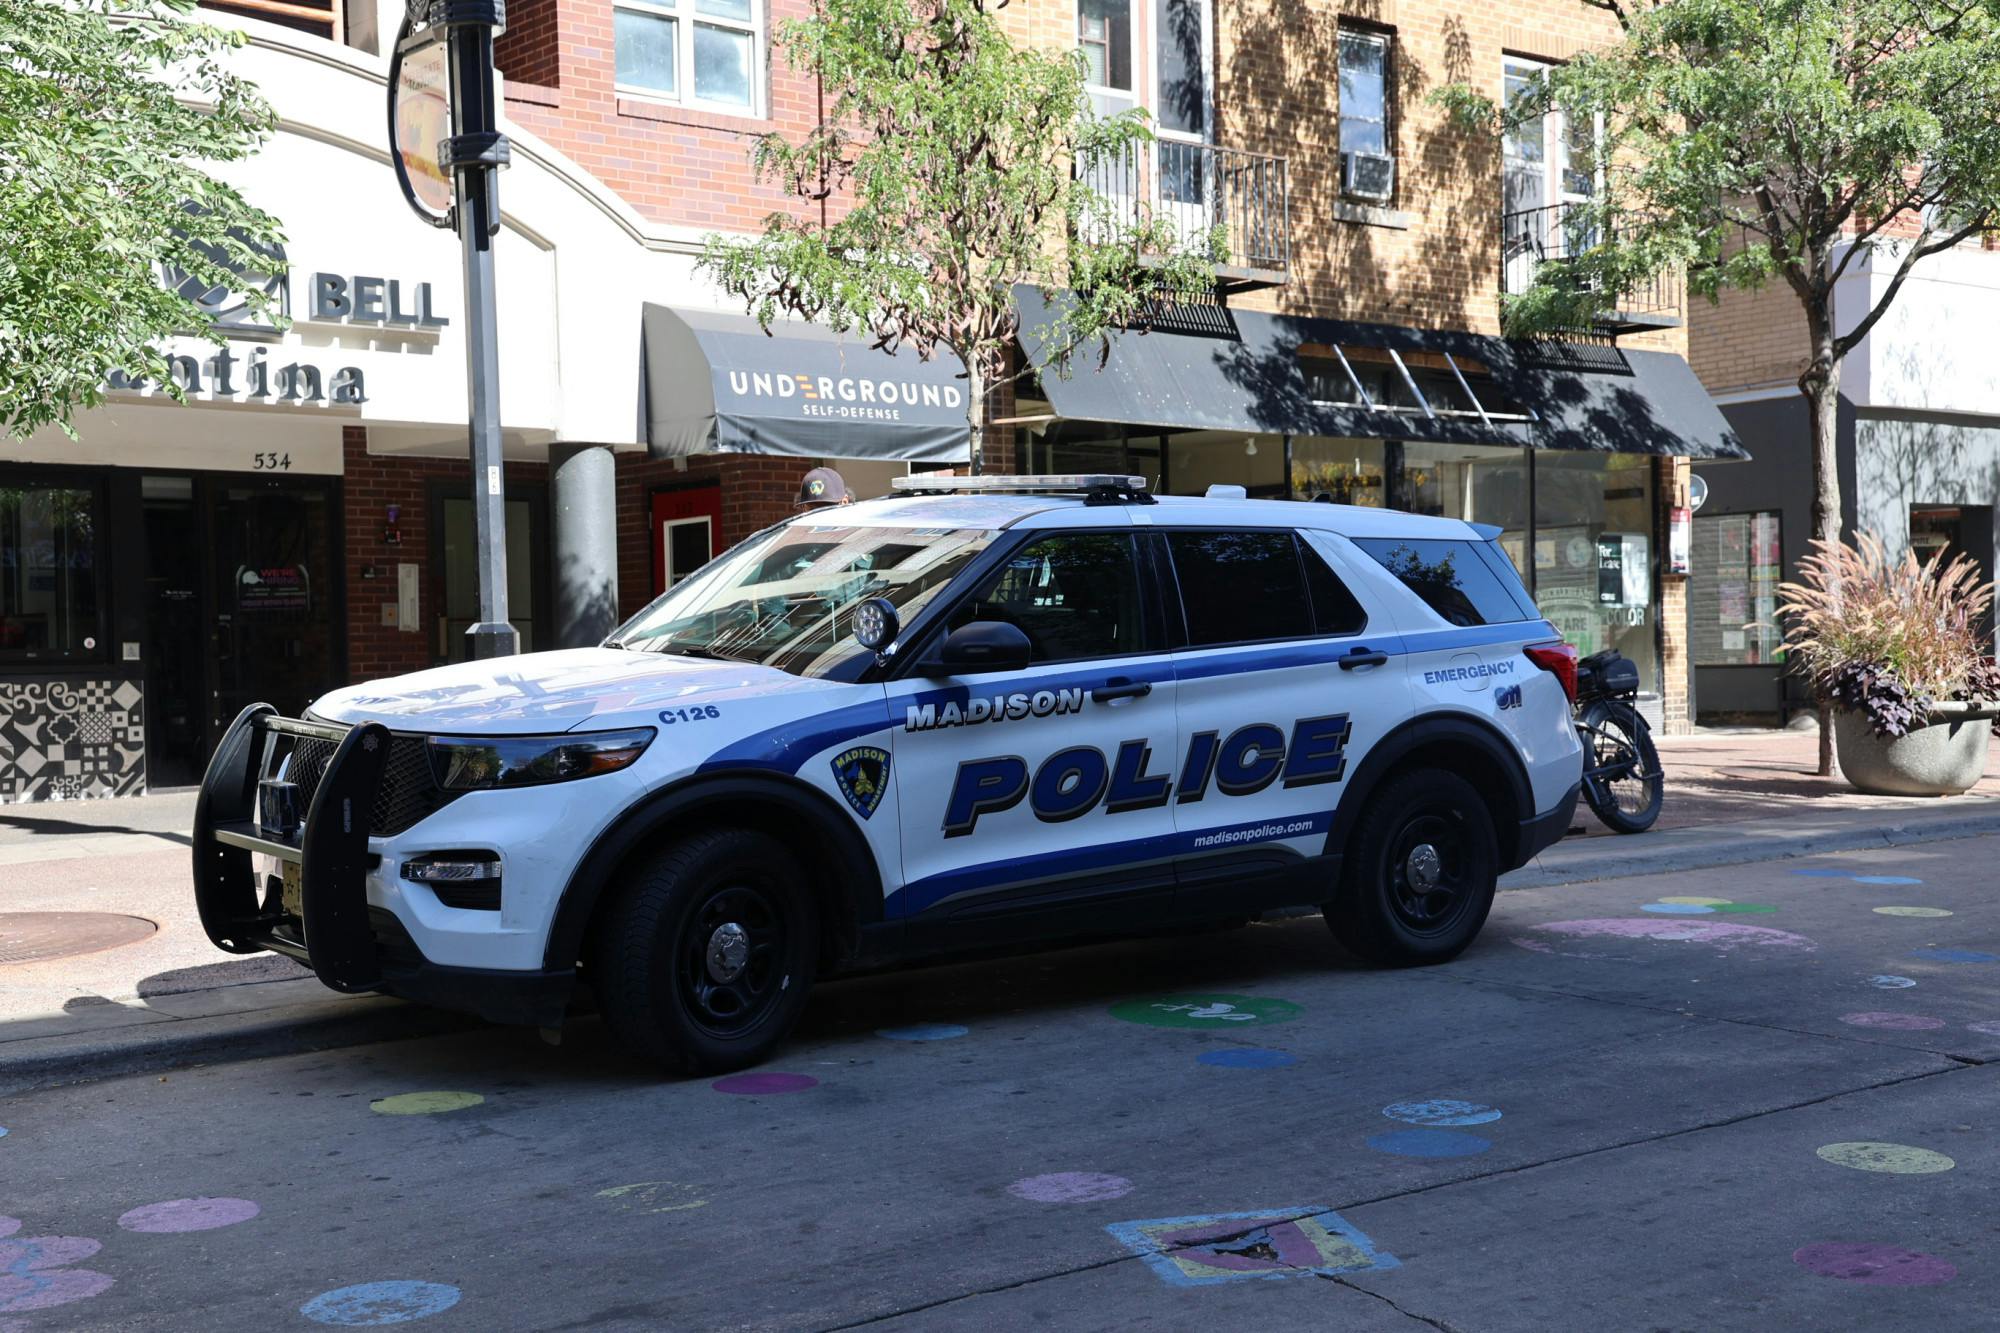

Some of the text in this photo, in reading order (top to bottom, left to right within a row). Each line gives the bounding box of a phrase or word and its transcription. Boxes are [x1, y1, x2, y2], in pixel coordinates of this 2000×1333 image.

[309, 272, 450, 326] BELL
[103, 346, 370, 404] antina
[729, 371, 962, 408] UNDERGROUND
[803, 404, 900, 420] SELF-DEFENSE
[253, 452, 292, 471] 534
[1424, 661, 1515, 684] EMERGENCY
[659, 705, 720, 724] C126
[904, 687, 1083, 732] MADISON
[835, 748, 886, 768] MADISON
[941, 712, 1352, 839] POLICE
[1194, 820, 1313, 847] madisonpolice.com
